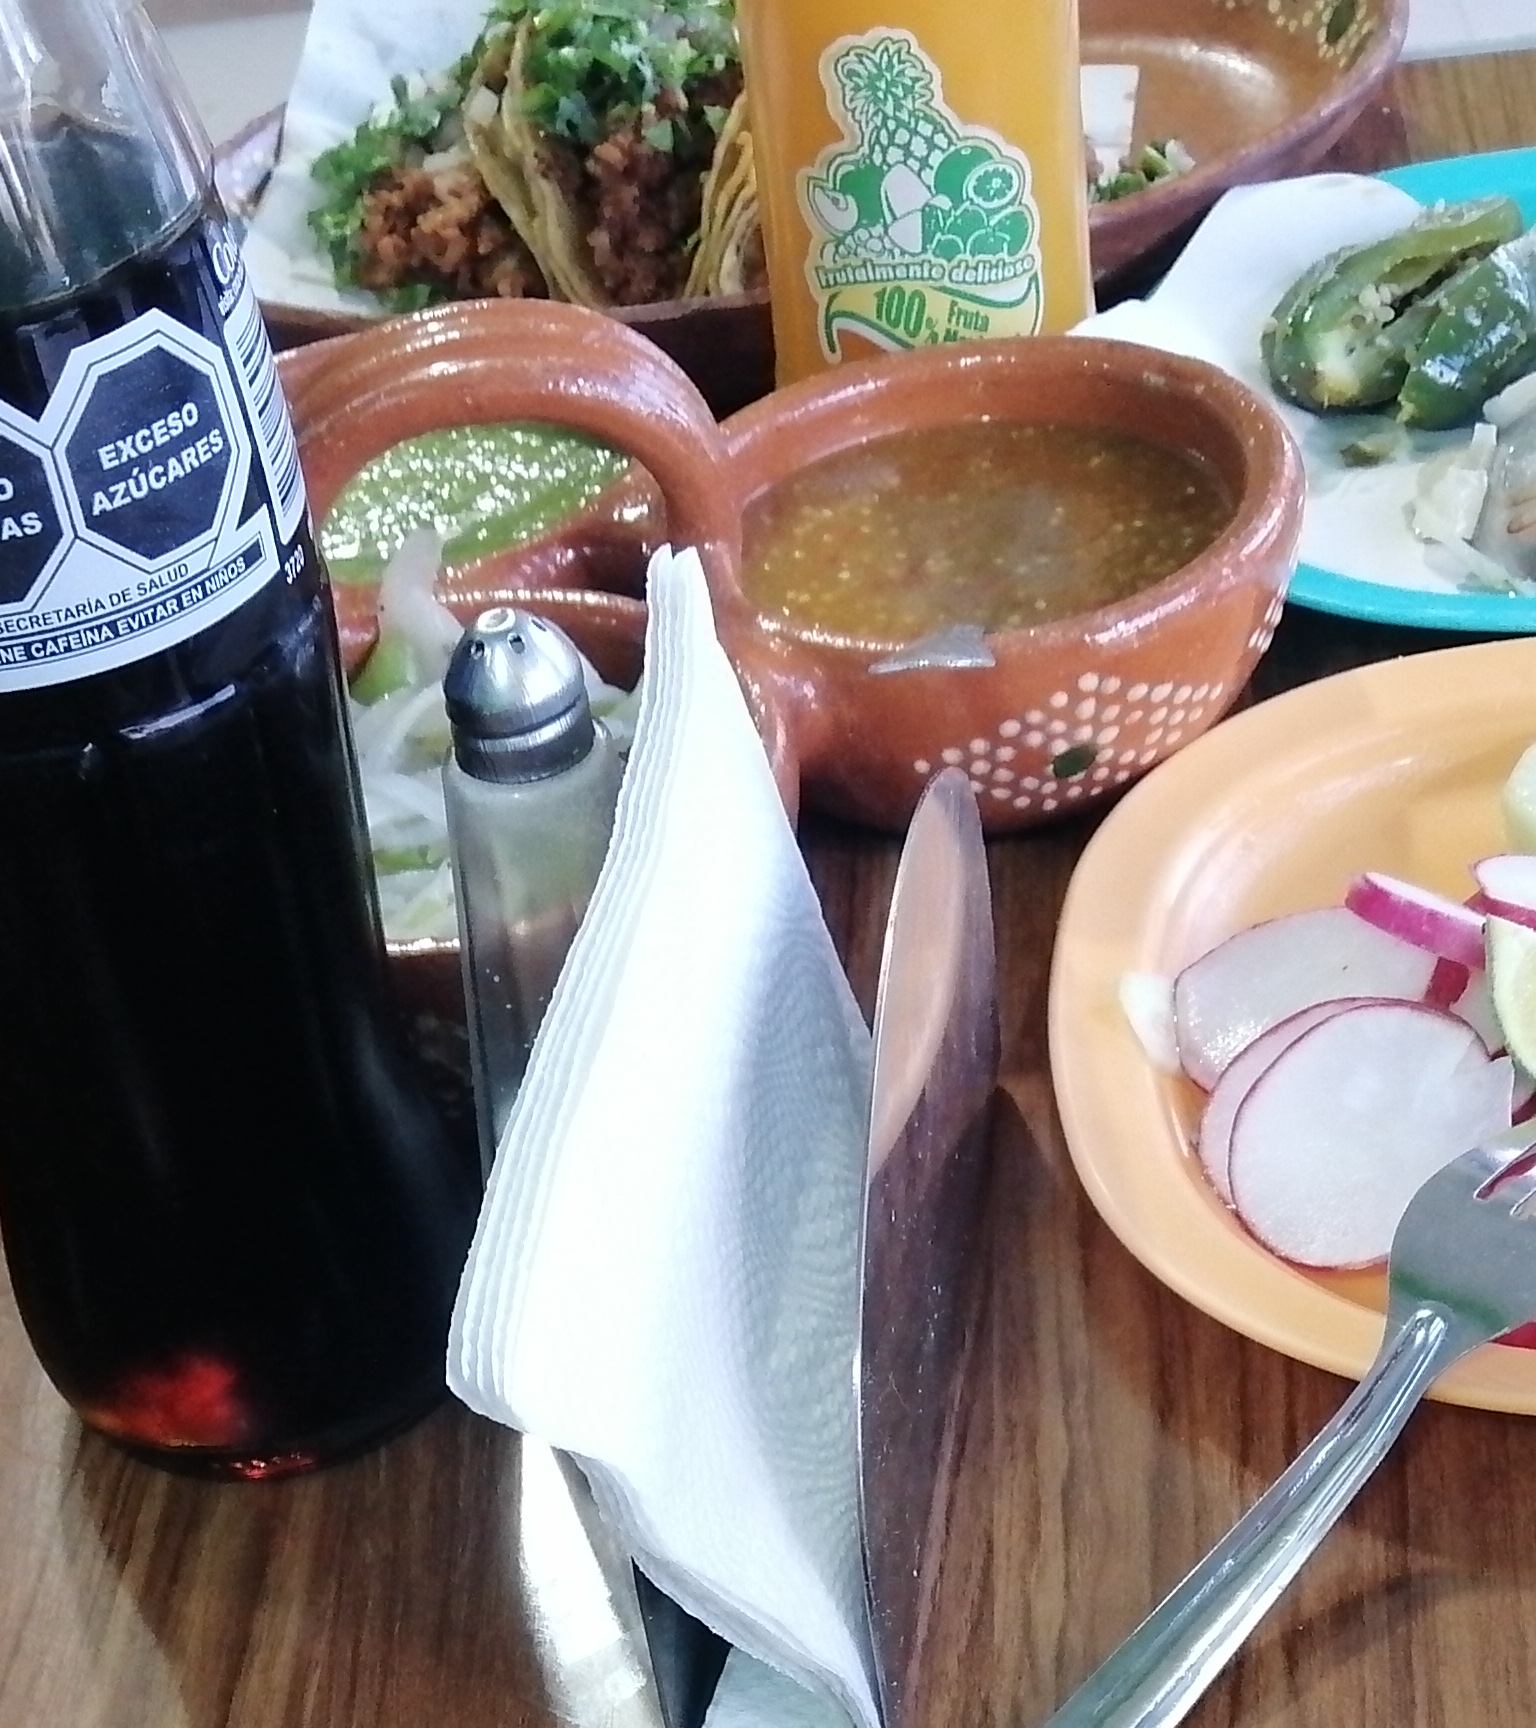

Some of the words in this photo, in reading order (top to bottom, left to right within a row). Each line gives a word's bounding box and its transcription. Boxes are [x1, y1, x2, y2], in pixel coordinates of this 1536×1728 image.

[949, 254, 1035, 284] delicioso
[98, 402, 199, 471] EXCESO
[91, 429, 224, 516] AZÚCARES
[31, 623, 113, 658] CAFEÍNA
[118, 598, 179, 636] EVITAR
[182, 585, 204, 610] EN
[205, 556, 246, 601] NIÑOS
[110, 587, 132, 608] DE
[136, 562, 190, 598] SALUD
